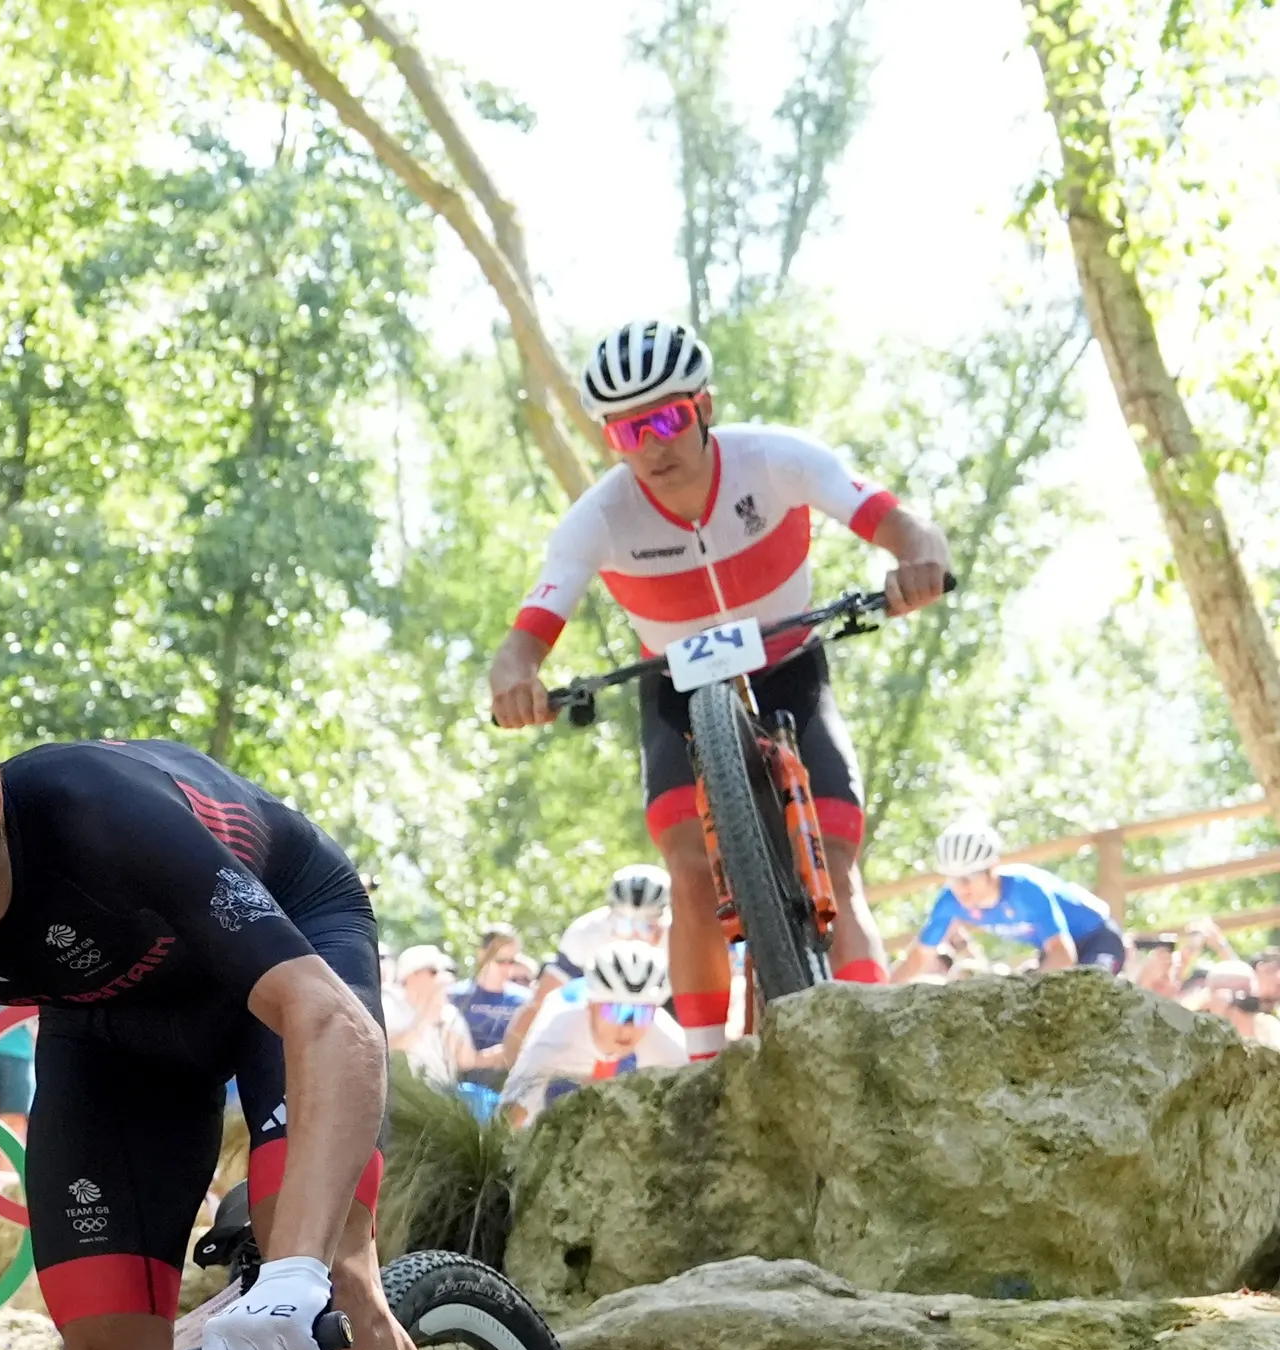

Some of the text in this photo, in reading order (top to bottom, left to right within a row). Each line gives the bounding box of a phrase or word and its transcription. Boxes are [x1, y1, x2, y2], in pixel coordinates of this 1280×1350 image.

[682, 627, 743, 661] 24
[55, 937, 95, 964] TEAM GB
[65, 1206, 110, 1218] TEAM GB
